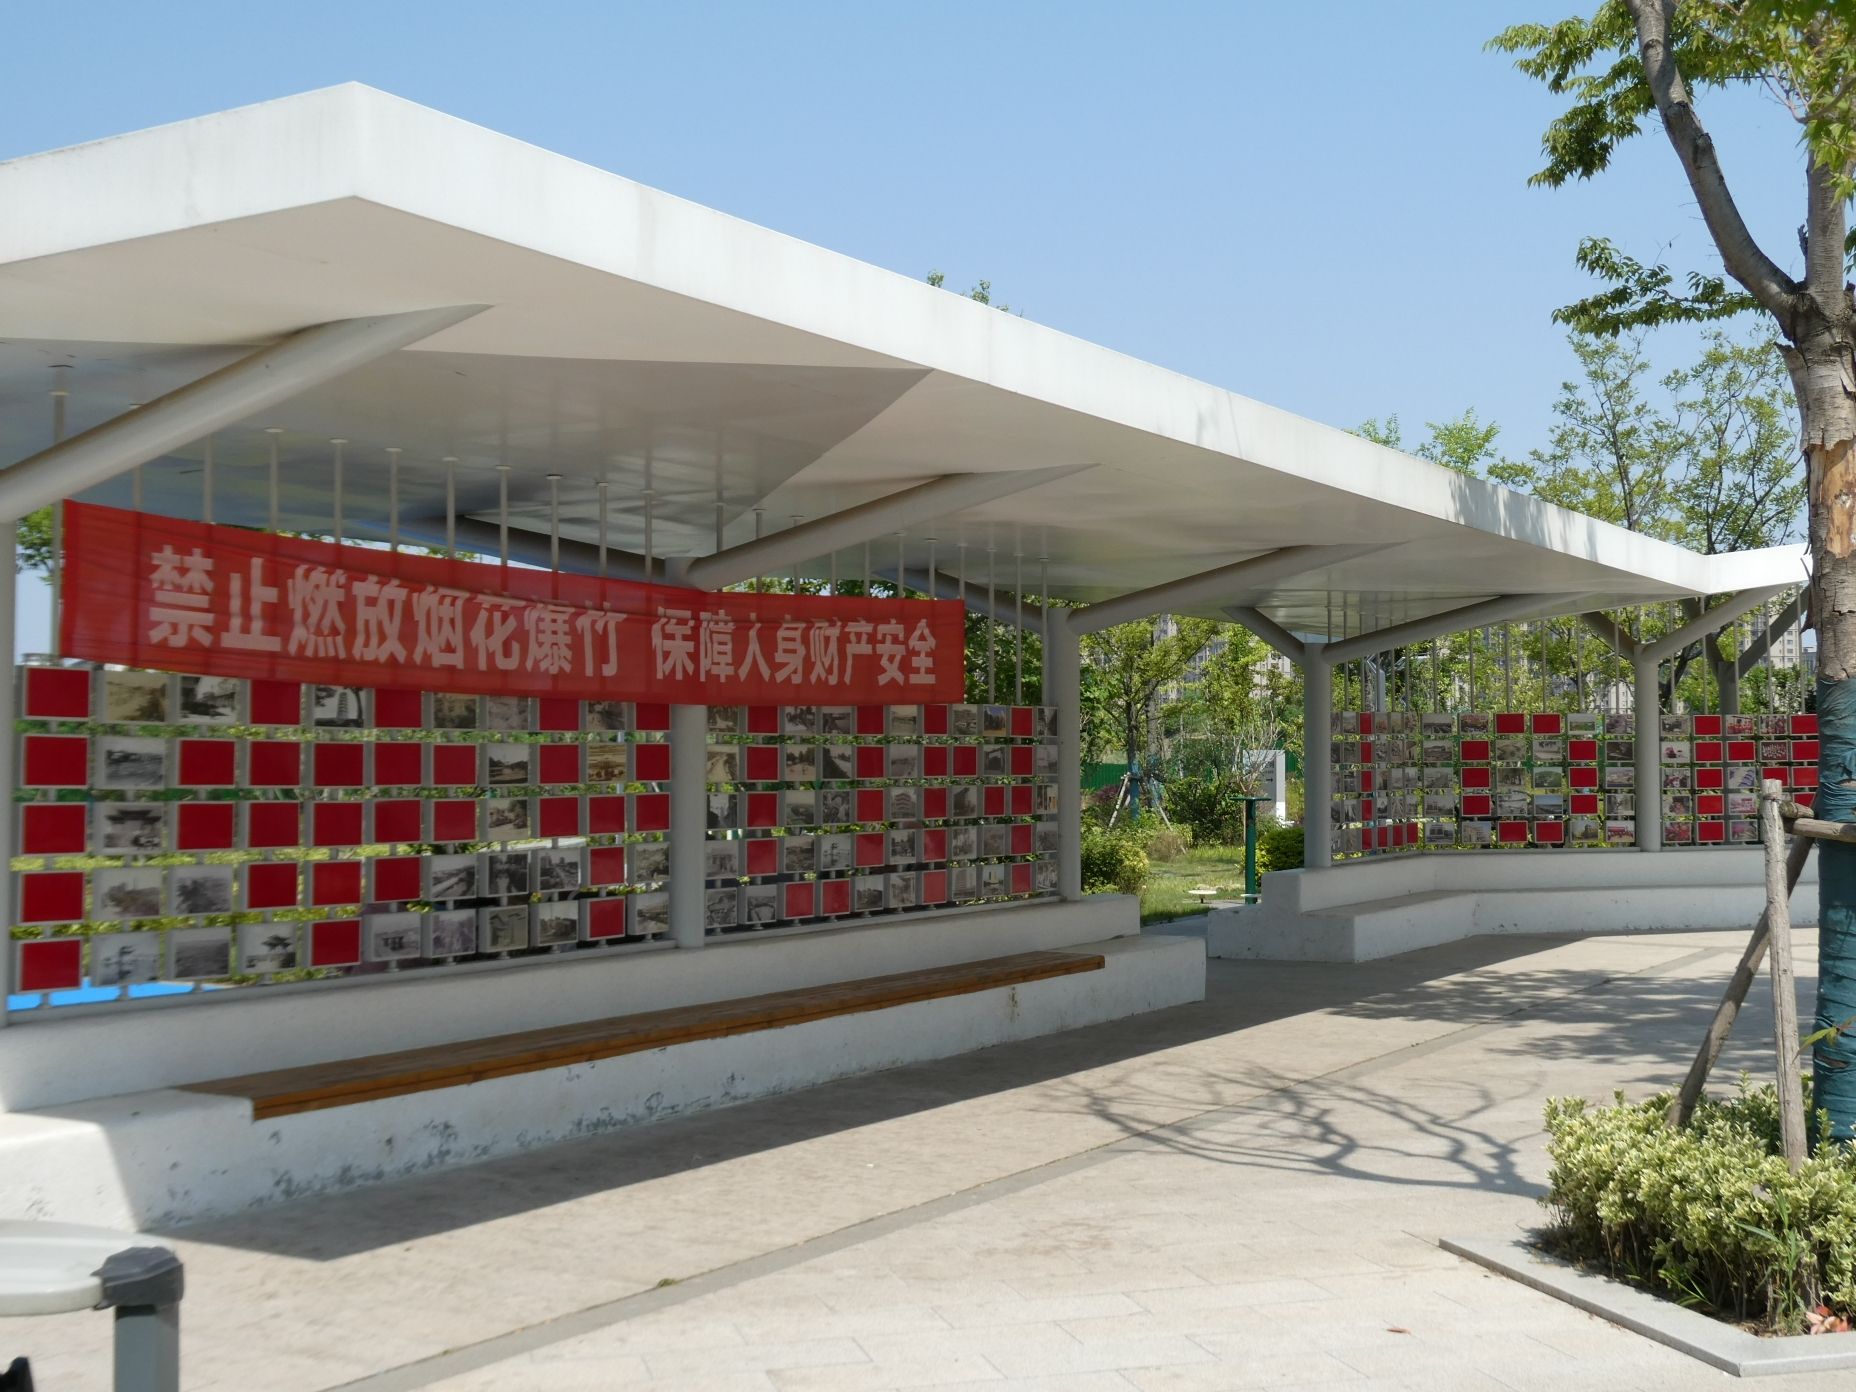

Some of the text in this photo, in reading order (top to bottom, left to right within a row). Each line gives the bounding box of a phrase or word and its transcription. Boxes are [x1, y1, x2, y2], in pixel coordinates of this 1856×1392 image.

[148, 545, 937, 686] 禁止燃放烟花爆竹 保障人身财产安全
